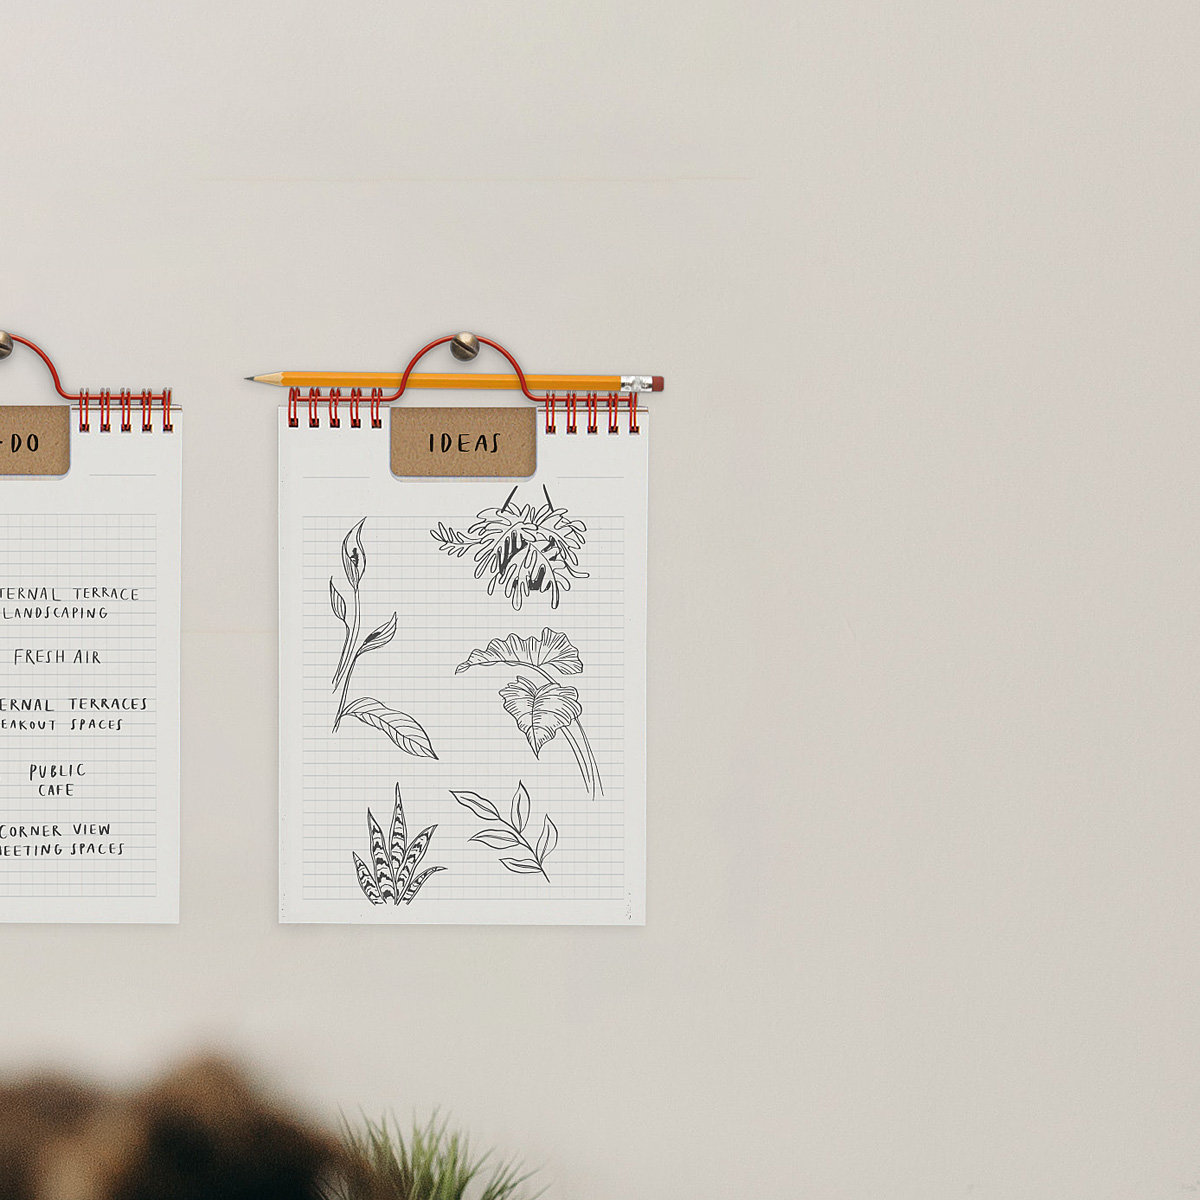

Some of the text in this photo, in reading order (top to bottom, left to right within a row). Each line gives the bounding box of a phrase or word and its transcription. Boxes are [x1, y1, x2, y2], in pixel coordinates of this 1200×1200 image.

[429, 432, 501, 454] IDEAS
[72, 586, 138, 601] TERRACE
[2, 605, 108, 620] LANDSCAPING
[14, 648, 101, 666] FRESH AIR
[69, 697, 147, 711] TERRACES
[70, 718, 123, 731] SPACES
[29, 763, 86, 781] PUBLIC
[38, 783, 74, 797] CAFE
[72, 823, 110, 836] VIEW
[70, 842, 123, 856] SPACES
